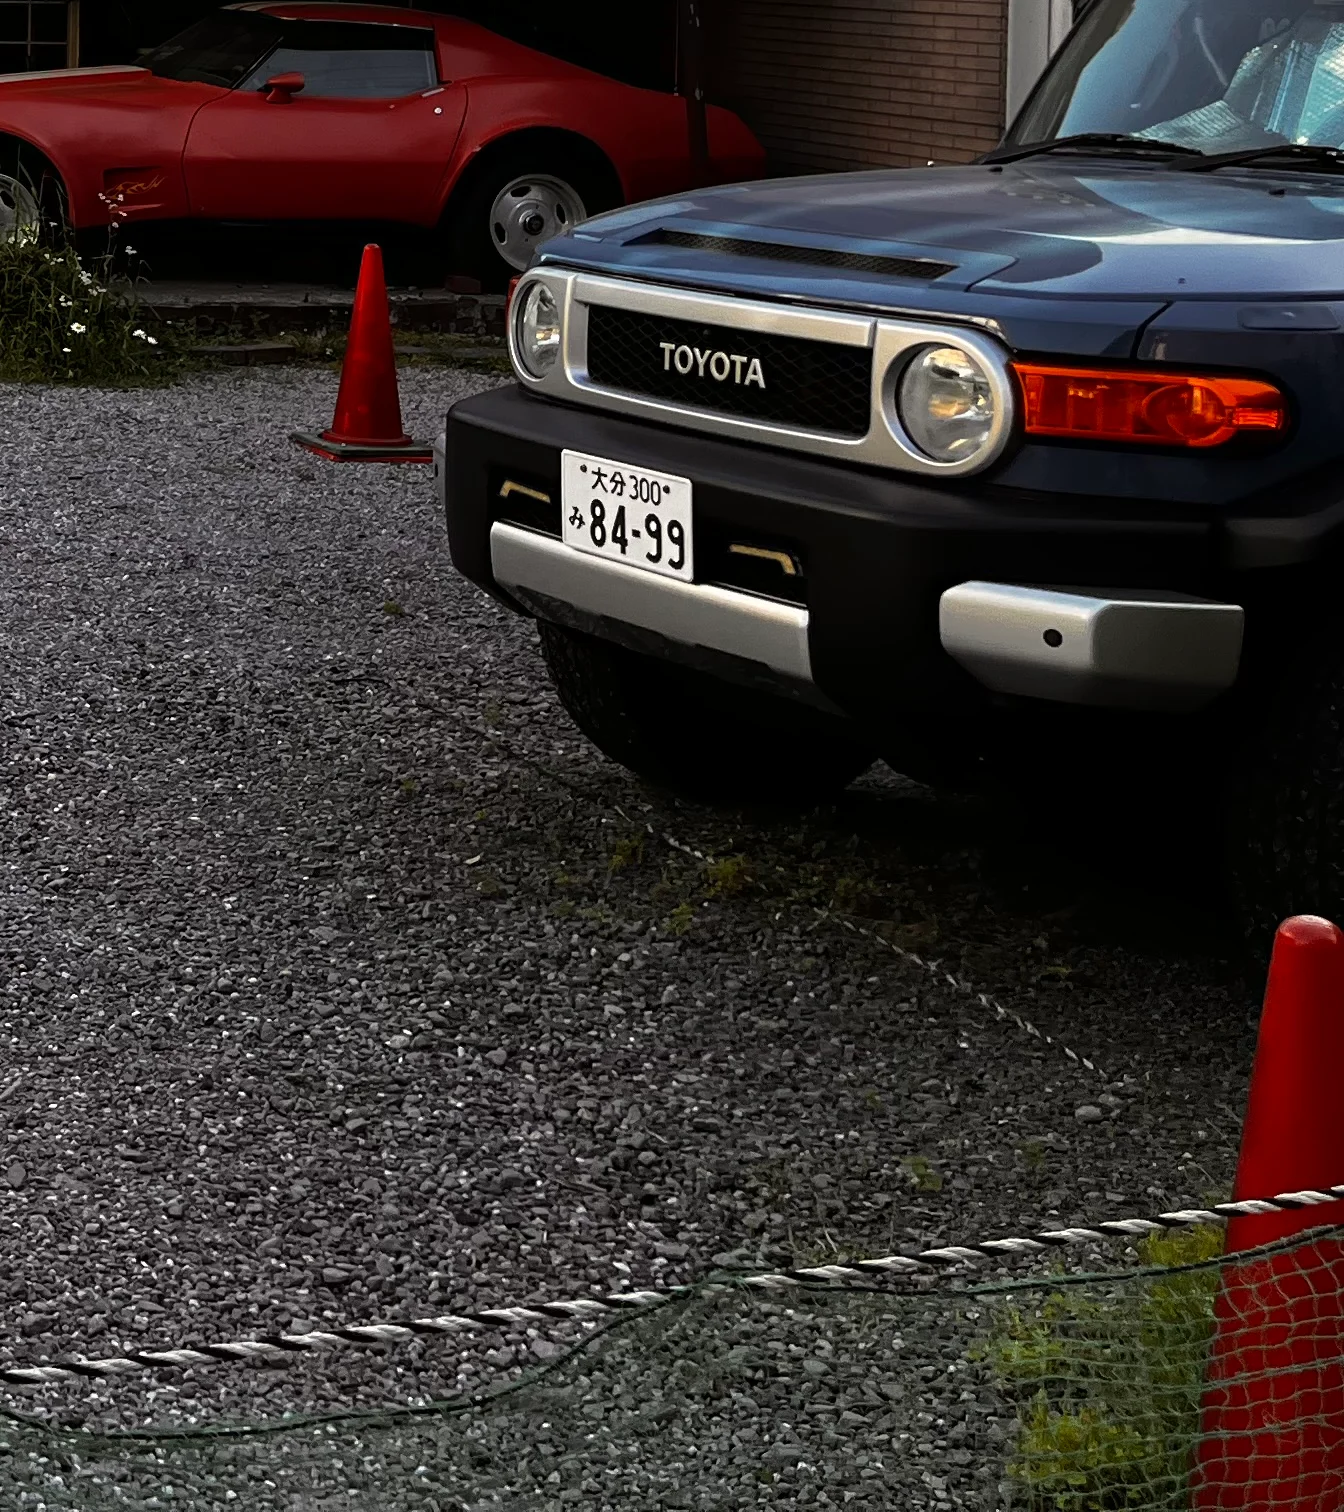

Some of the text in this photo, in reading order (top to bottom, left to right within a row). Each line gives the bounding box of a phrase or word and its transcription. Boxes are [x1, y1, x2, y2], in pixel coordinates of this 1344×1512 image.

[659, 342, 766, 389] TOYOTA
[568, 498, 686, 571] み 84-99
